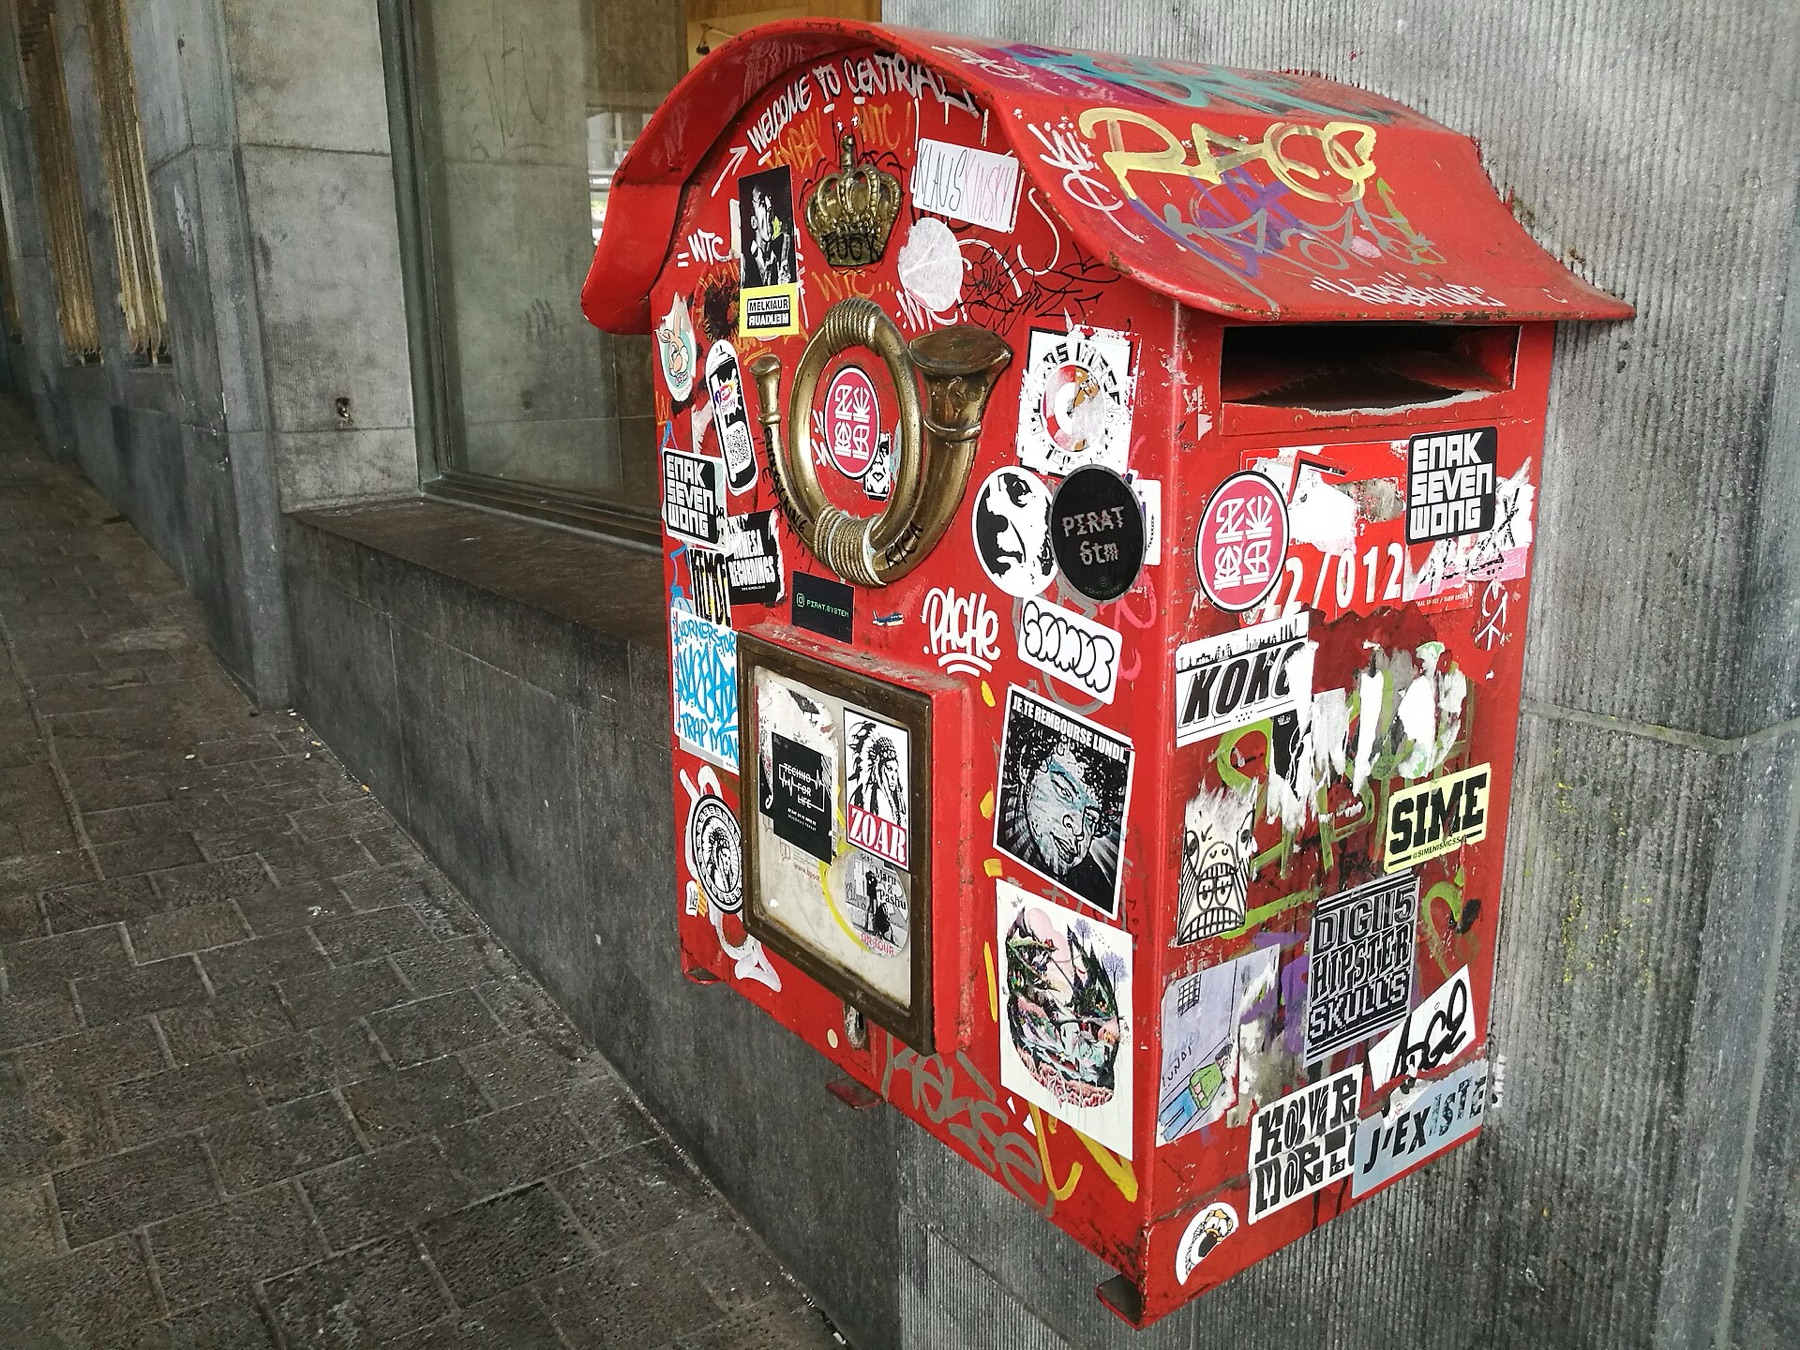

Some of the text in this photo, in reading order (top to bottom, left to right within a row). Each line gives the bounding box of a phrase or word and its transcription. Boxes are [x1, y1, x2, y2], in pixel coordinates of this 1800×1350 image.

[747, 73, 812, 154] WELCOME
[812, 63, 841, 101] TO
[667, 479, 714, 516] SEVEN
[1411, 462, 1494, 507] SEVEN
[667, 503, 709, 539] WONG
[1061, 506, 1124, 538] PIRAT
[1409, 497, 1481, 540] WONG
[1012, 695, 1023, 713] JE
[1023, 699, 1035, 719] TE
[1034, 705, 1093, 748] REMBOURSE
[797, 782, 812, 797] FOR
[1389, 772, 1487, 855] SIME
[850, 808, 906, 864] ZOAR
[1311, 924, 1412, 1003] HIPSTER
[1309, 969, 1409, 1040] SKULLS
